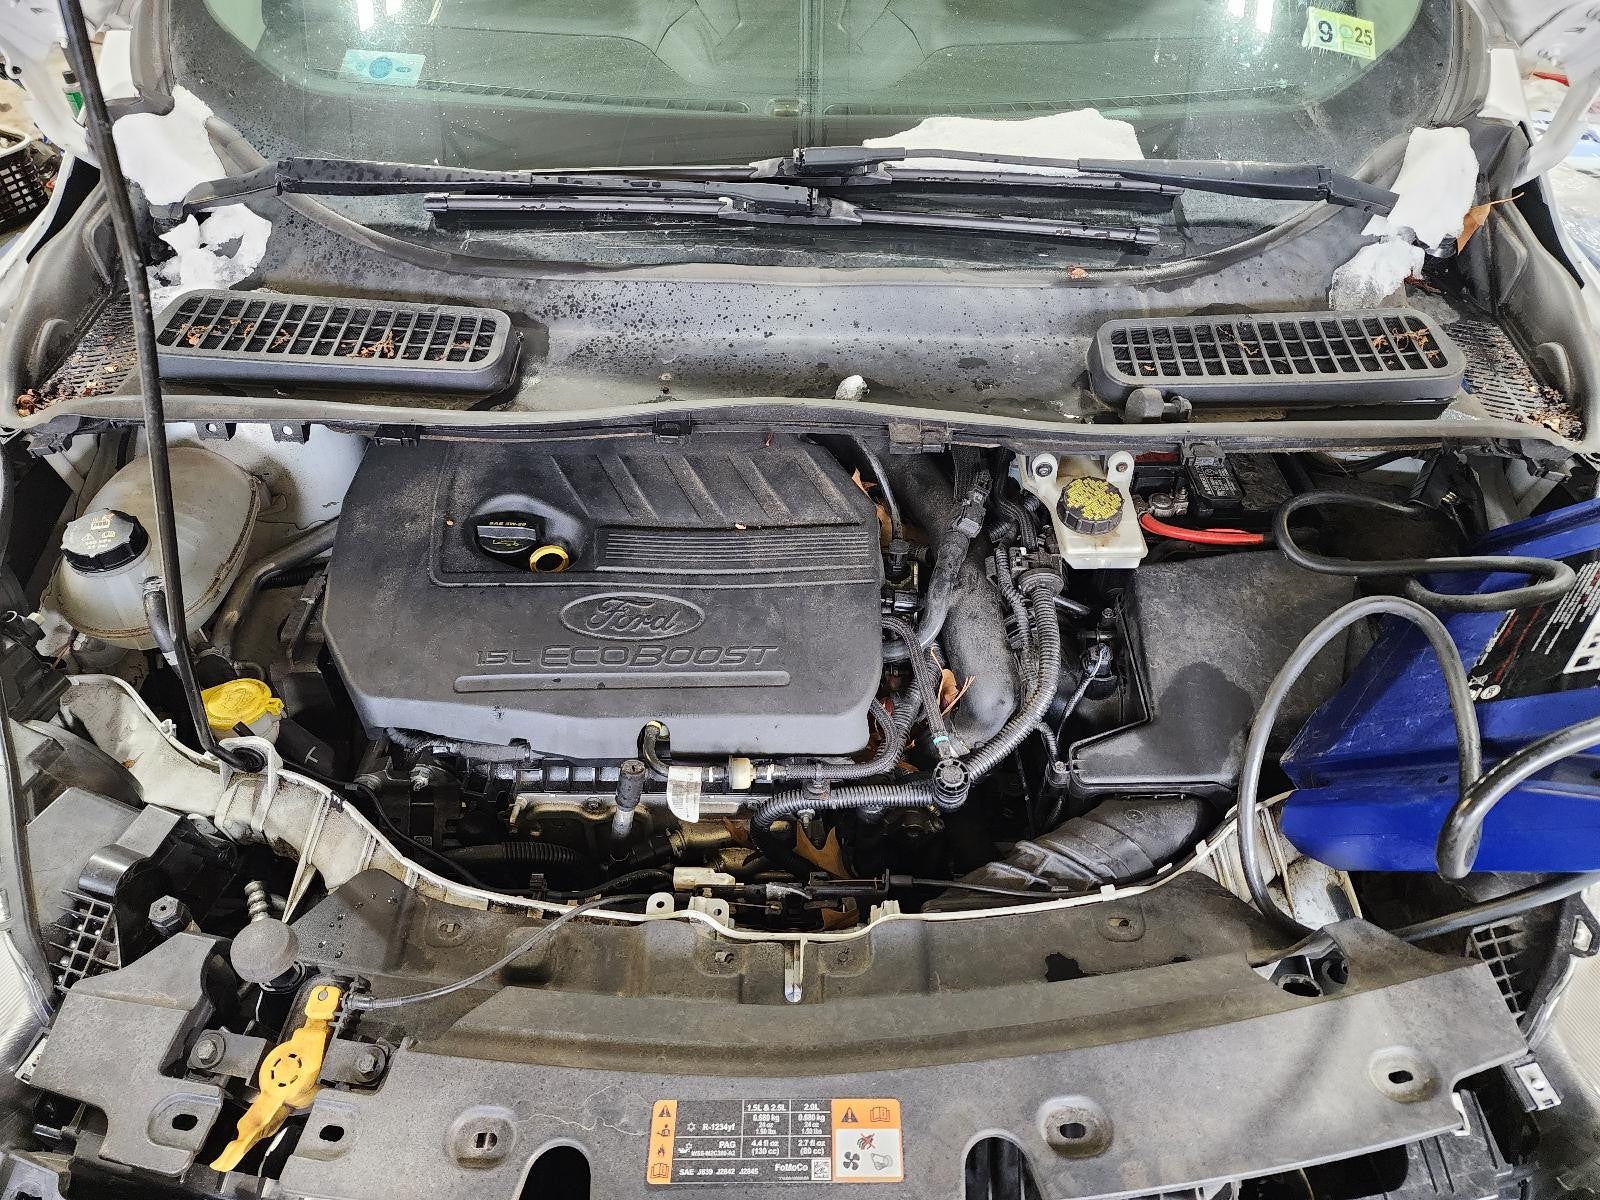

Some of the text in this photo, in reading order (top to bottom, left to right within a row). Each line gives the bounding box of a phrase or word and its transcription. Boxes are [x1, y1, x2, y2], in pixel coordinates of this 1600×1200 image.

[1318, 20, 1333, 43] 9
[1355, 27, 1373, 46] 25
[585, 596, 682, 633] Ford
[746, 1103, 762, 1111] 1.5L
[763, 1103, 770, 1111] &
[803, 1103, 820, 1111] 2.0L
[771, 1113, 780, 1122] kg
[816, 1113, 826, 1122] kg
[702, 1122, 736, 1132] R-1234yf
[718, 1141, 736, 1149] PAG
[751, 1139, 763, 1147] 4.4
[797, 1139, 809, 1147] 2.7
[751, 1147, 780, 1156] (130 cc)
[800, 1147, 825, 1156] (80 cc)
[774, 1162, 809, 1172] FoMoCo
[679, 1168, 695, 1176] SAE
